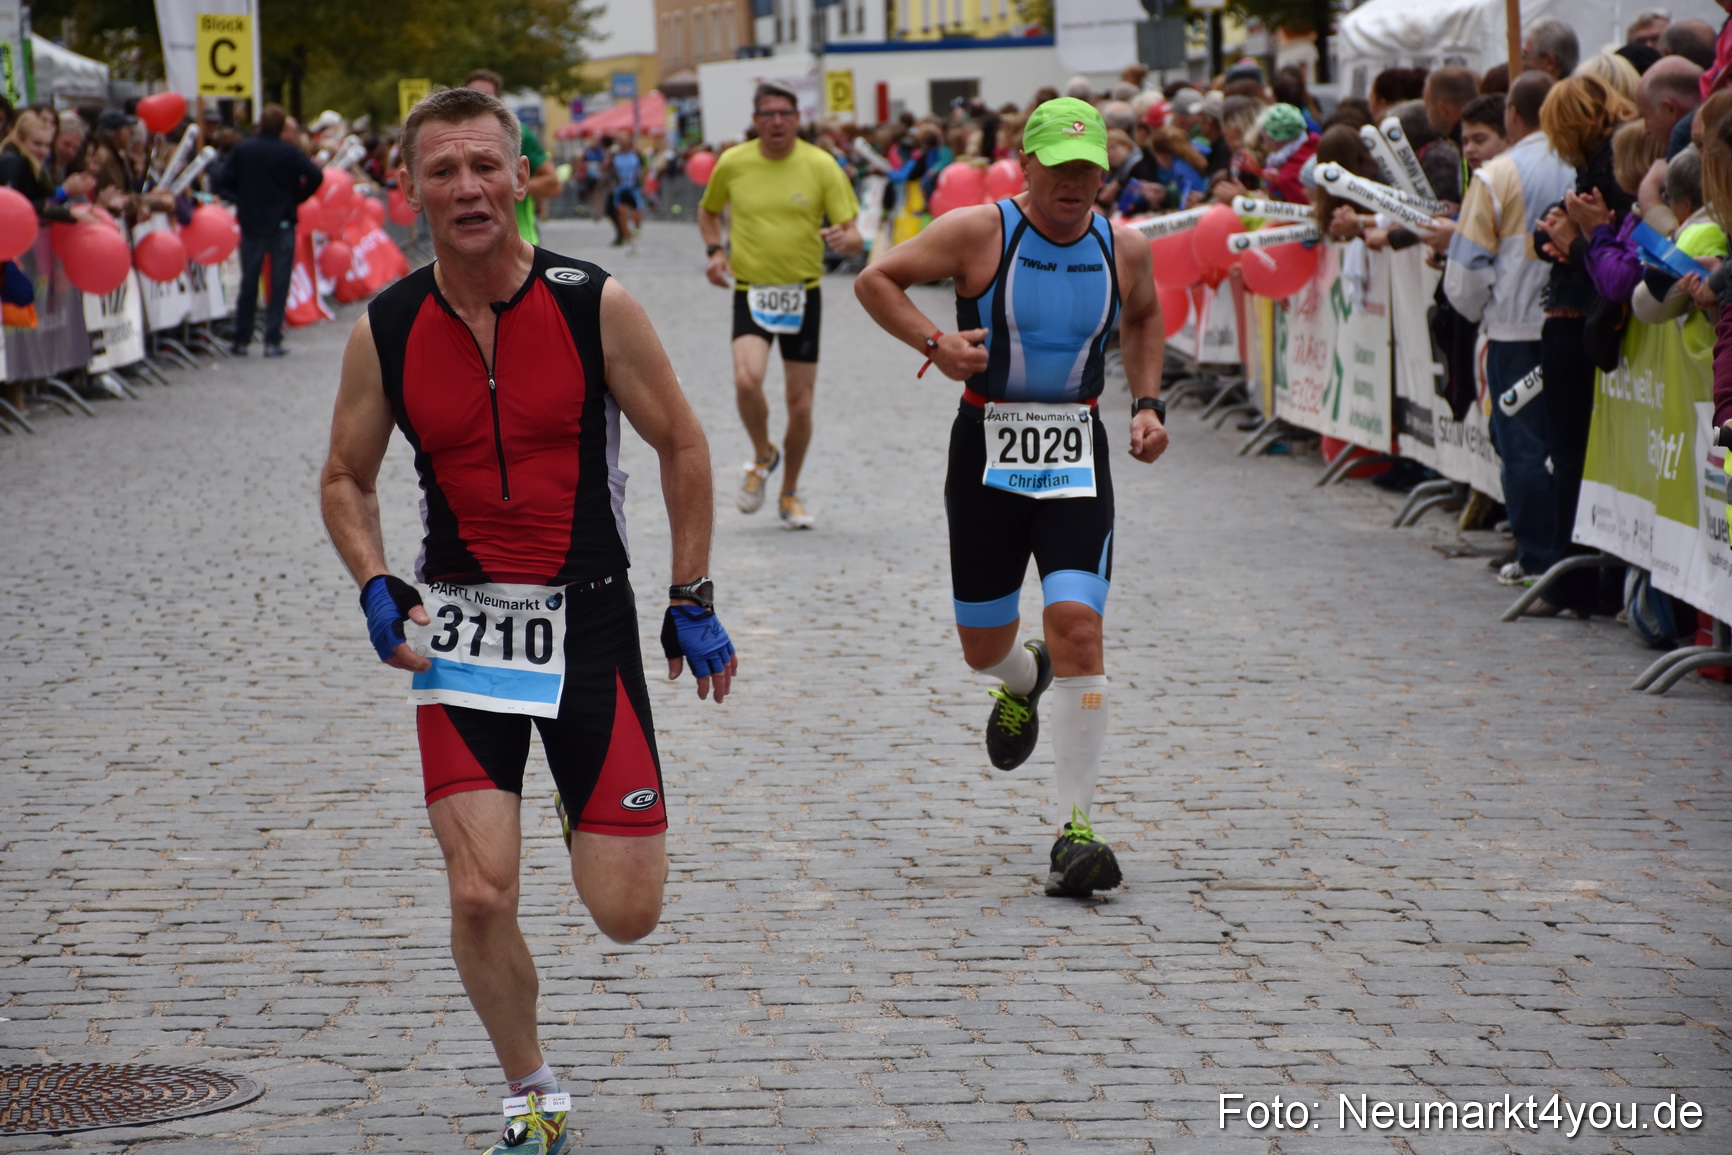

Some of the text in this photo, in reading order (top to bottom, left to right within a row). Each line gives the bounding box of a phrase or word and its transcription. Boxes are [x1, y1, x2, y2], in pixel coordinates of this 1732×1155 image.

[201, 15, 246, 32] Block
[209, 37, 237, 78] C
[1026, 412, 1075, 422] Neumarkt
[998, 427, 1082, 464] 2029
[1009, 473, 1069, 489] Christian
[430, 581, 540, 611] PARTL Neumarkt
